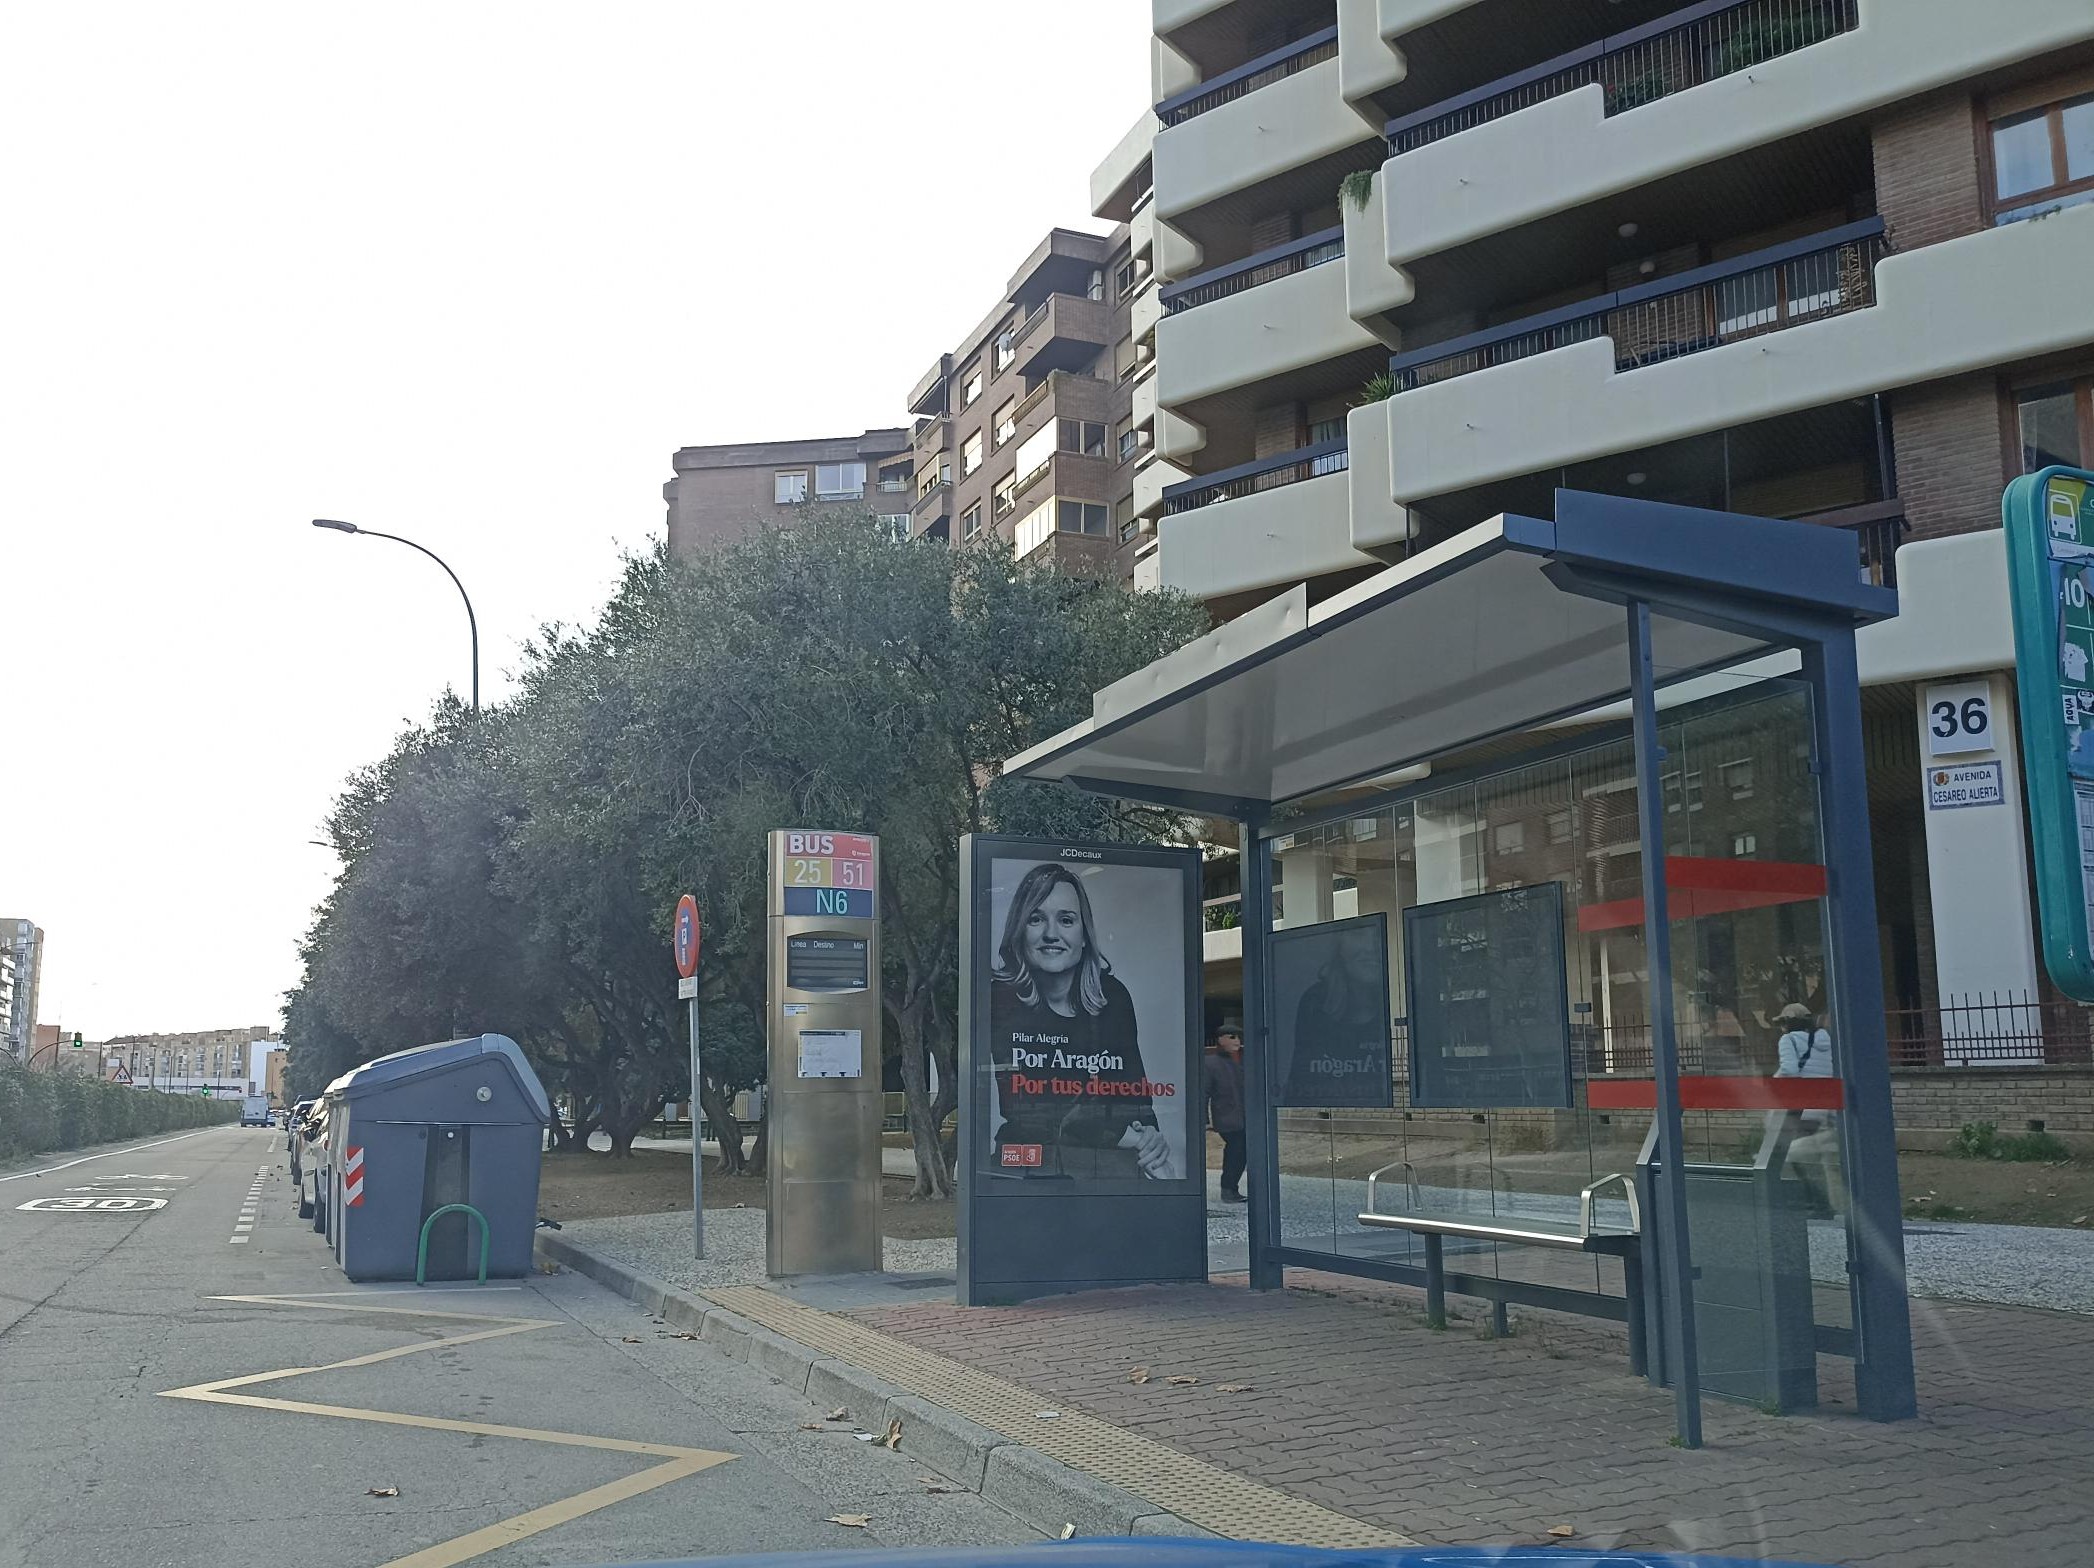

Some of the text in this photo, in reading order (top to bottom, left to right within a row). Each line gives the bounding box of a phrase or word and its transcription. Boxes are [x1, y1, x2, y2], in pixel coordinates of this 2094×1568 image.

[2064, 577, 2085, 608] 10
[1932, 697, 1988, 738] 36
[1954, 770, 1992, 782] AVENIDA
[1933, 786, 1998, 803] CESAREO ALIERTA
[789, 834, 834, 855] BUS
[1060, 848, 1102, 859] JCDecaux
[794, 860, 821, 884] 25
[842, 861, 863, 886] 51
[816, 889, 848, 915] N6
[1012, 1032, 1034, 1043] Pilar
[1012, 1047, 1124, 1075] Por Aragón
[1011, 1074, 1176, 1097] Por tus derechos
